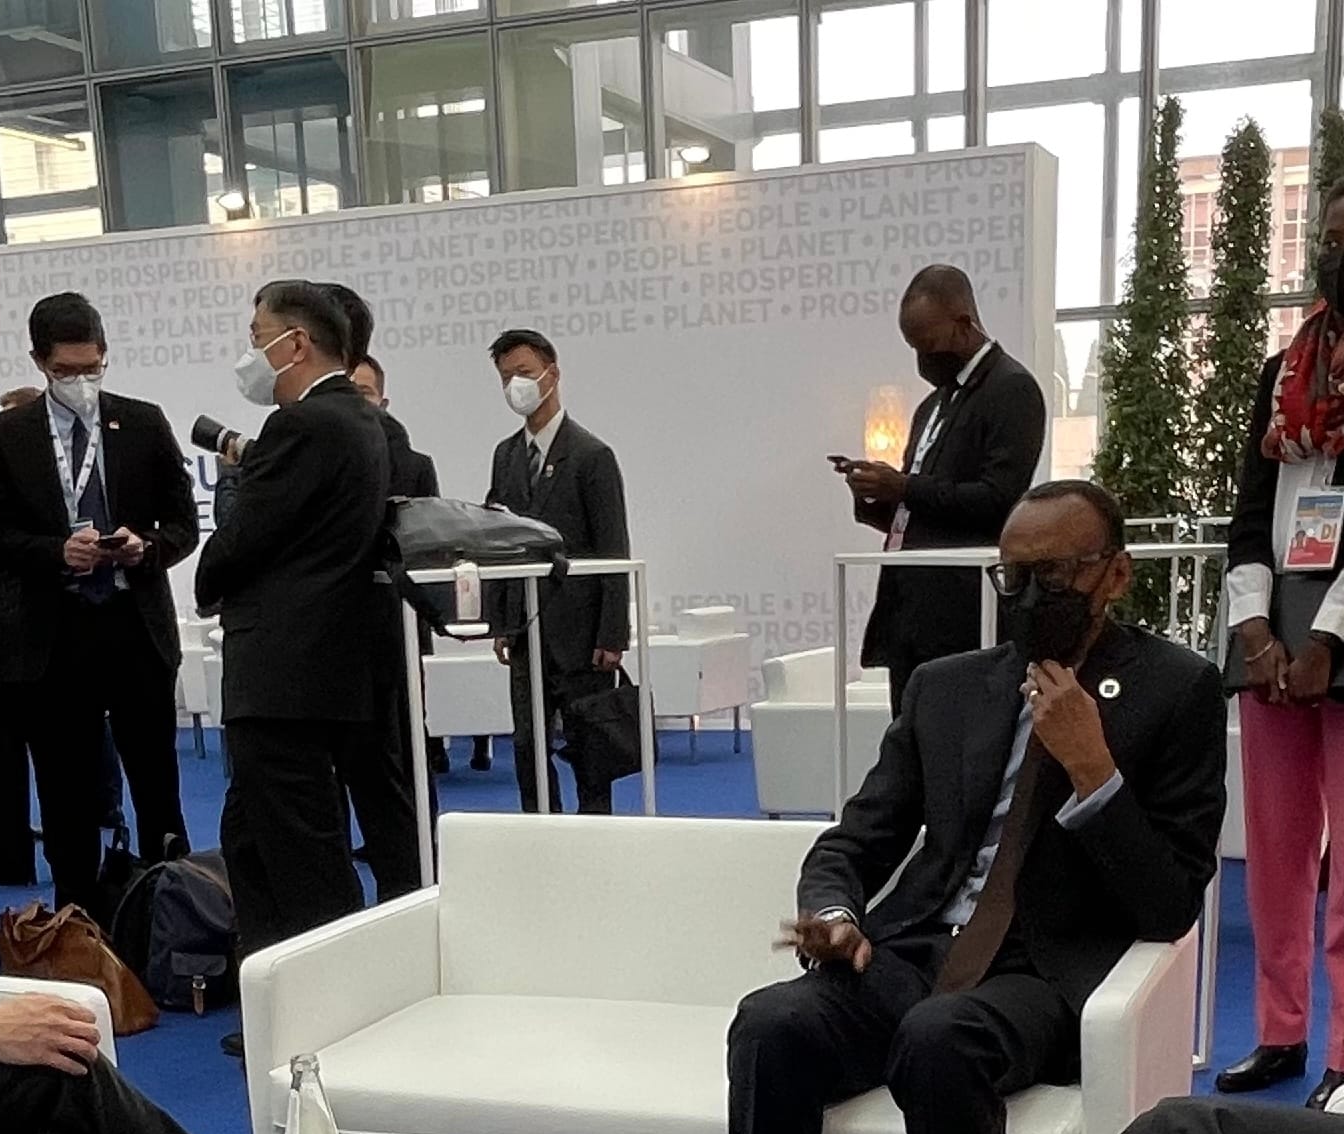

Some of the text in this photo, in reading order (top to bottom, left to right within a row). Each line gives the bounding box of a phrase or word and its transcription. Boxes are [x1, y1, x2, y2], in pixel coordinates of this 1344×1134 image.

[95, 256, 237, 288] PROSPERITY
[261, 243, 356, 275] PEOPLE
[378, 233, 478, 264] PLANET
[503, 215, 673, 252] PROSPERITY
[700, 200, 812, 237] PEOPLE
[840, 185, 960, 222] PLANET
[416, 252, 580, 290] PROSPERITY
[606, 241, 713, 274] PEOPLE
[740, 228, 855, 263] PLANET
[125, 341, 214, 368] PEOPLE
[663, 297, 773, 331] PLANET
[152, 312, 243, 339] PLANET
[441, 285, 542, 317] PEOPLE
[567, 275, 674, 306] PLANET
[699, 258, 881, 297] PROSPERITY
